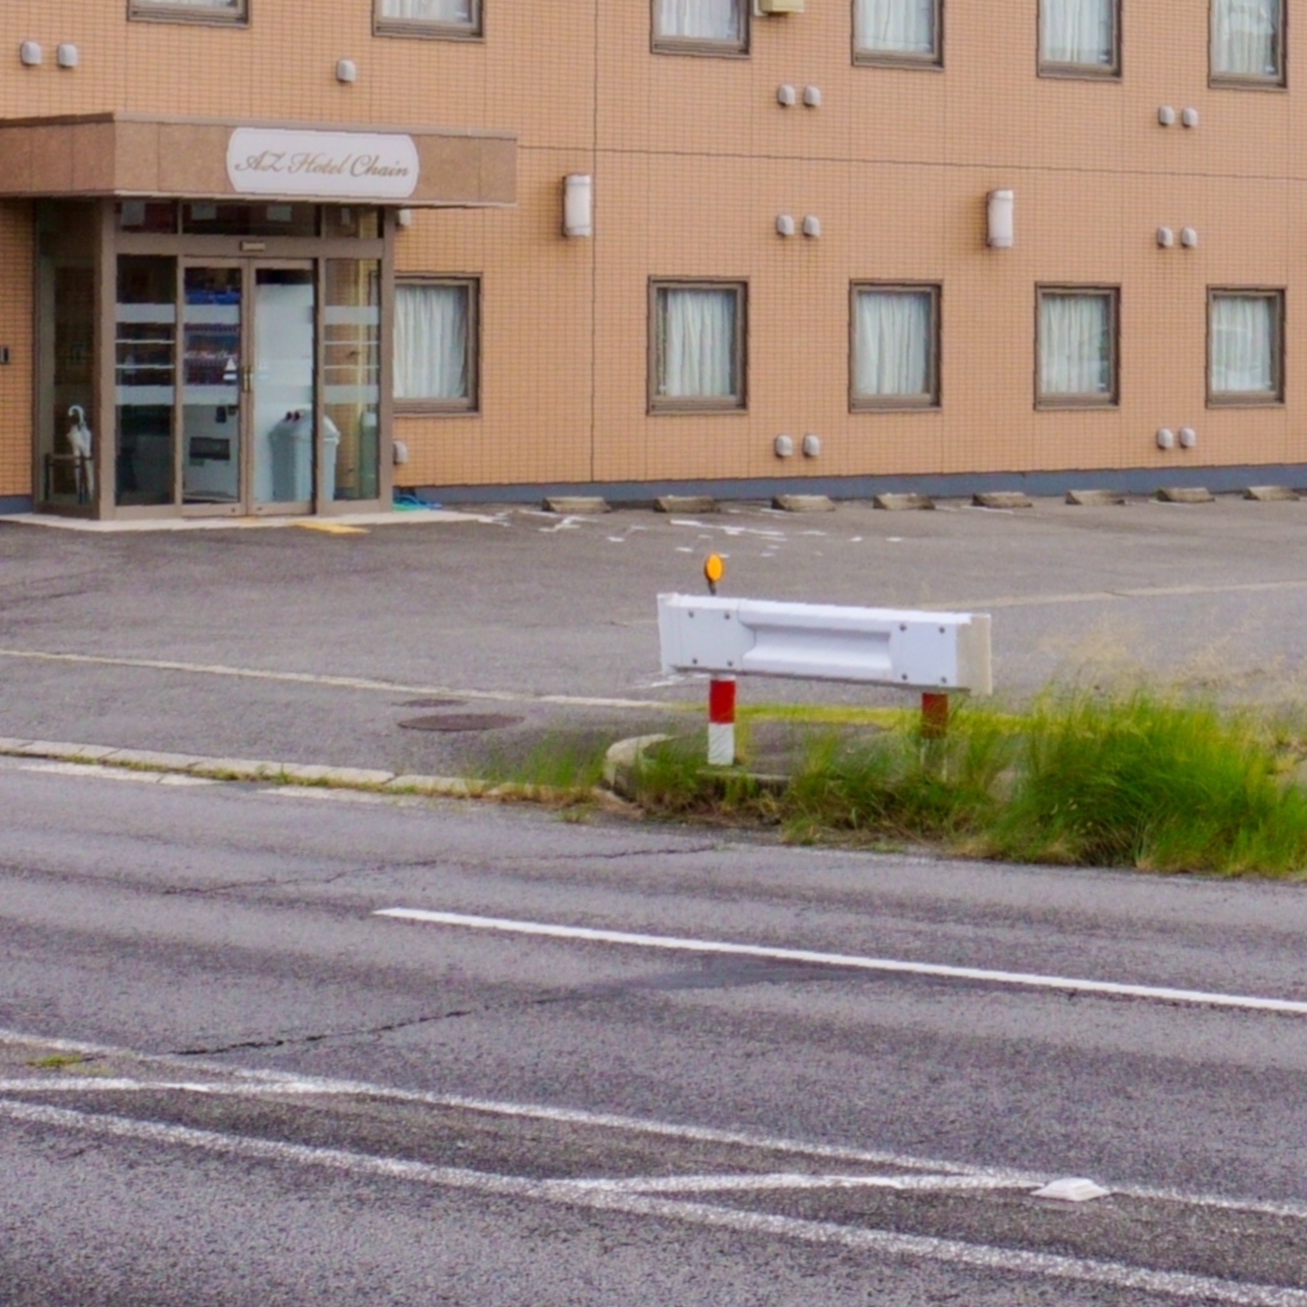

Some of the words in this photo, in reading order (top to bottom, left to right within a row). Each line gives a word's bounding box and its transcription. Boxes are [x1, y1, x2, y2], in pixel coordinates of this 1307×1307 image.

[234, 150, 286, 173] AZ
[286, 152, 353, 176] Hotel
[349, 153, 410, 178] Chain
